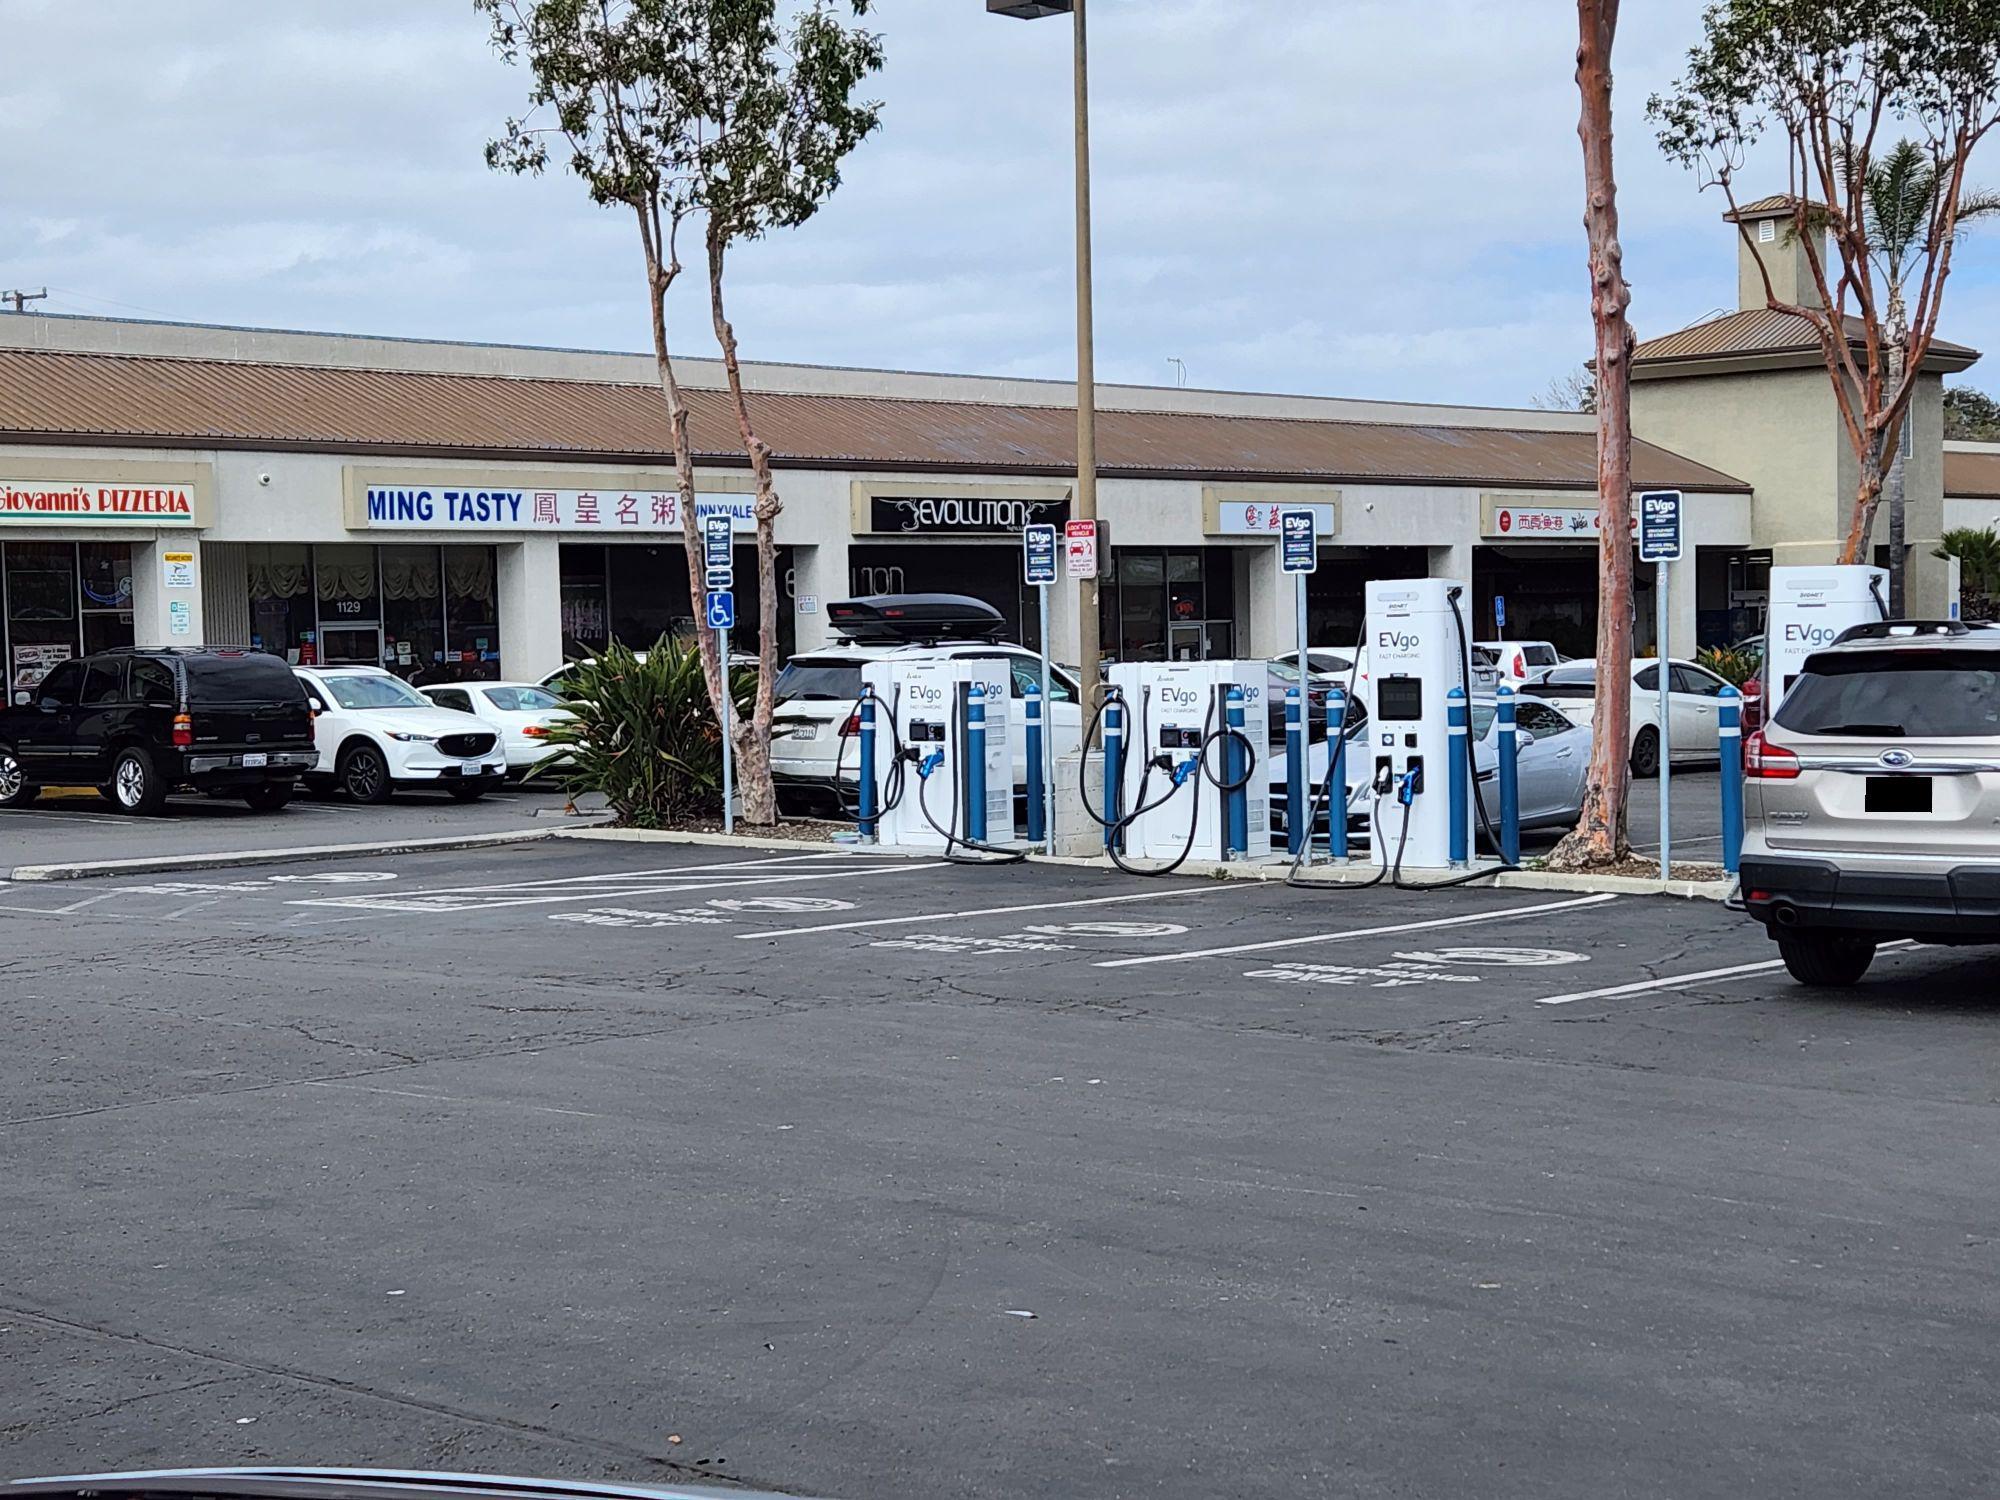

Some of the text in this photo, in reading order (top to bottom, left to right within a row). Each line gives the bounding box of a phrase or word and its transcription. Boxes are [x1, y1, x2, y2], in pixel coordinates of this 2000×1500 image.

[97, 488, 190, 513] PIZZERIA
[367, 490, 522, 522] MING TASTY
[532, 492, 676, 525] 鳳皇名粥
[1645, 499, 1676, 514] EVgo
[696, 504, 752, 519] NNYVALE
[919, 499, 1026, 525] EVOLUTION
[708, 521, 729, 532] EVgo
[1285, 517, 1310, 531] EVgo
[1028, 532, 1051, 544] EVgo
[336, 601, 361, 613] 1129
[1379, 631, 1420, 652] EVgo
[1785, 624, 1835, 646] EVgo
[910, 685, 942, 703] EVgo
[1161, 687, 1198, 706] EVgo
